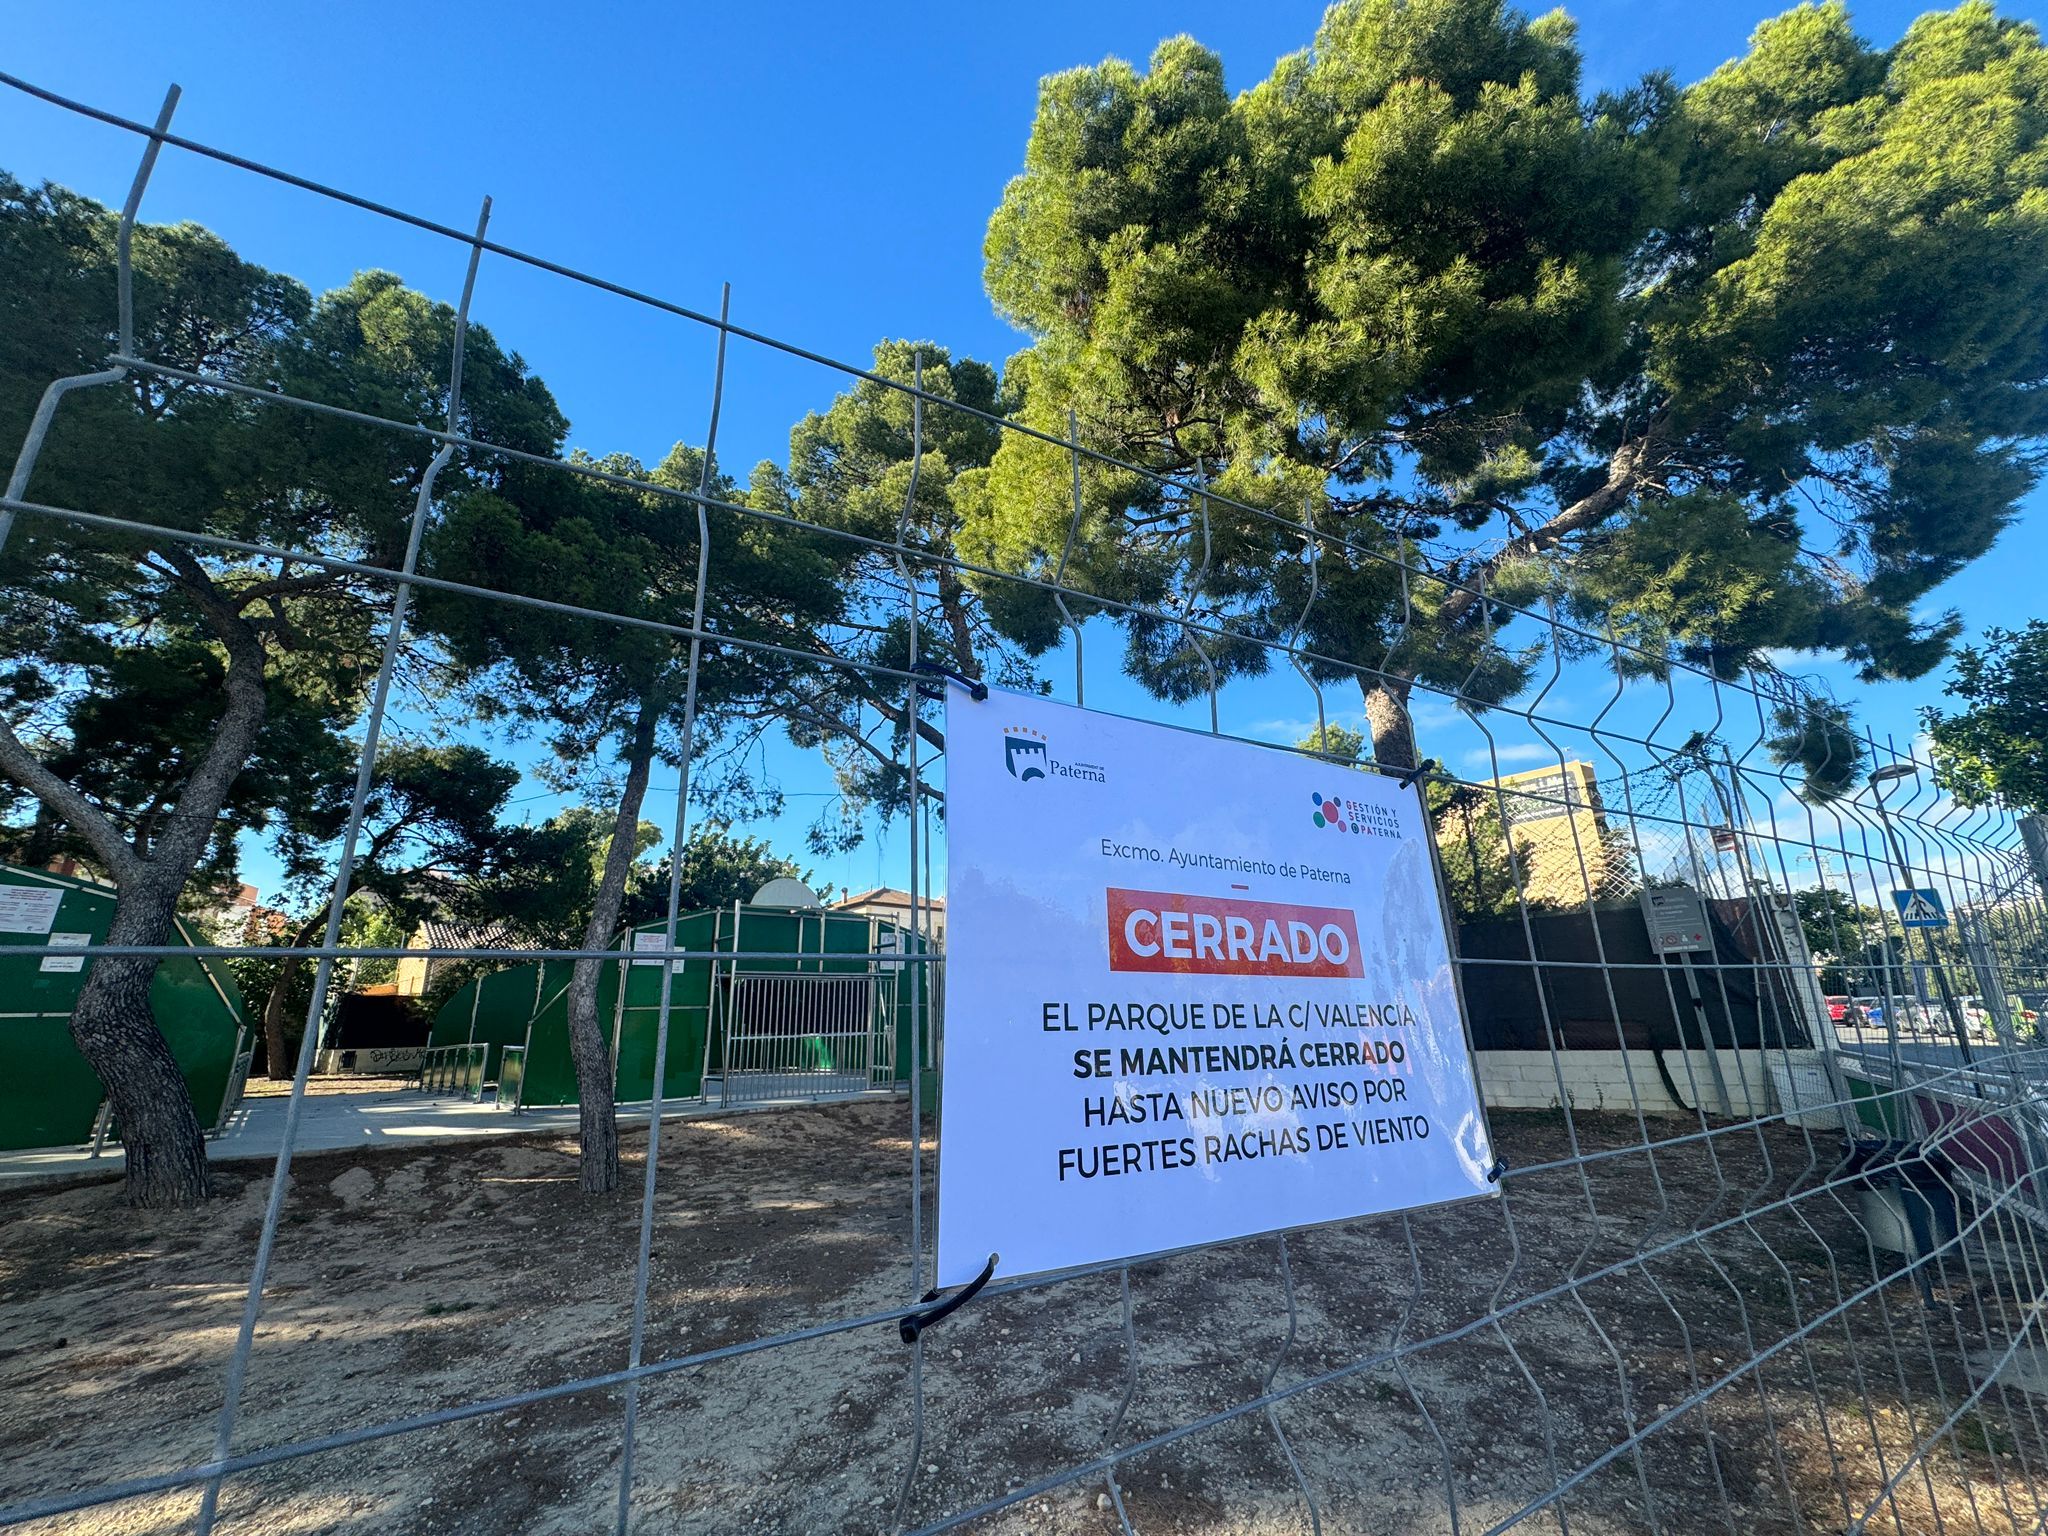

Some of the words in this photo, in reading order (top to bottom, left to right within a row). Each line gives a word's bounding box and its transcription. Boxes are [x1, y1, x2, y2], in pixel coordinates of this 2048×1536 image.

[1050, 760, 1106, 783] Paterna
[1346, 800, 1388, 817] GESTIÓN
[1391, 809, 1397, 817] Y
[1348, 811, 1399, 829] SERVICIOS
[1101, 838, 1164, 862] Excmo.
[1169, 847, 1276, 875] Ayuntamiento
[1279, 861, 1297, 878] de
[1300, 864, 1351, 884] Paterna
[1124, 908, 1350, 965] CERRADO
[1042, 1003, 1079, 1031] EL
[1088, 1003, 1206, 1035] PARQUE
[1213, 1004, 1247, 1029] DE
[1254, 1004, 1284, 1028] LA
[1314, 1004, 1416, 1027] VALENCIA
[1073, 1048, 1112, 1078] SE
[1120, 1037, 1296, 1076] MANTENDRÁ
[1299, 1040, 1405, 1068] CERRADO
[1084, 1092, 1184, 1127] HASTA
[1190, 1086, 1283, 1119] NUEVO
[1291, 1081, 1358, 1110] AVISO
[1363, 1078, 1408, 1104] POR
[1058, 1138, 1196, 1181] FUERTES
[1204, 1127, 1311, 1164] RACHAS
[1316, 1123, 1349, 1151] DE
[1352, 1115, 1430, 1146] VIENTO
